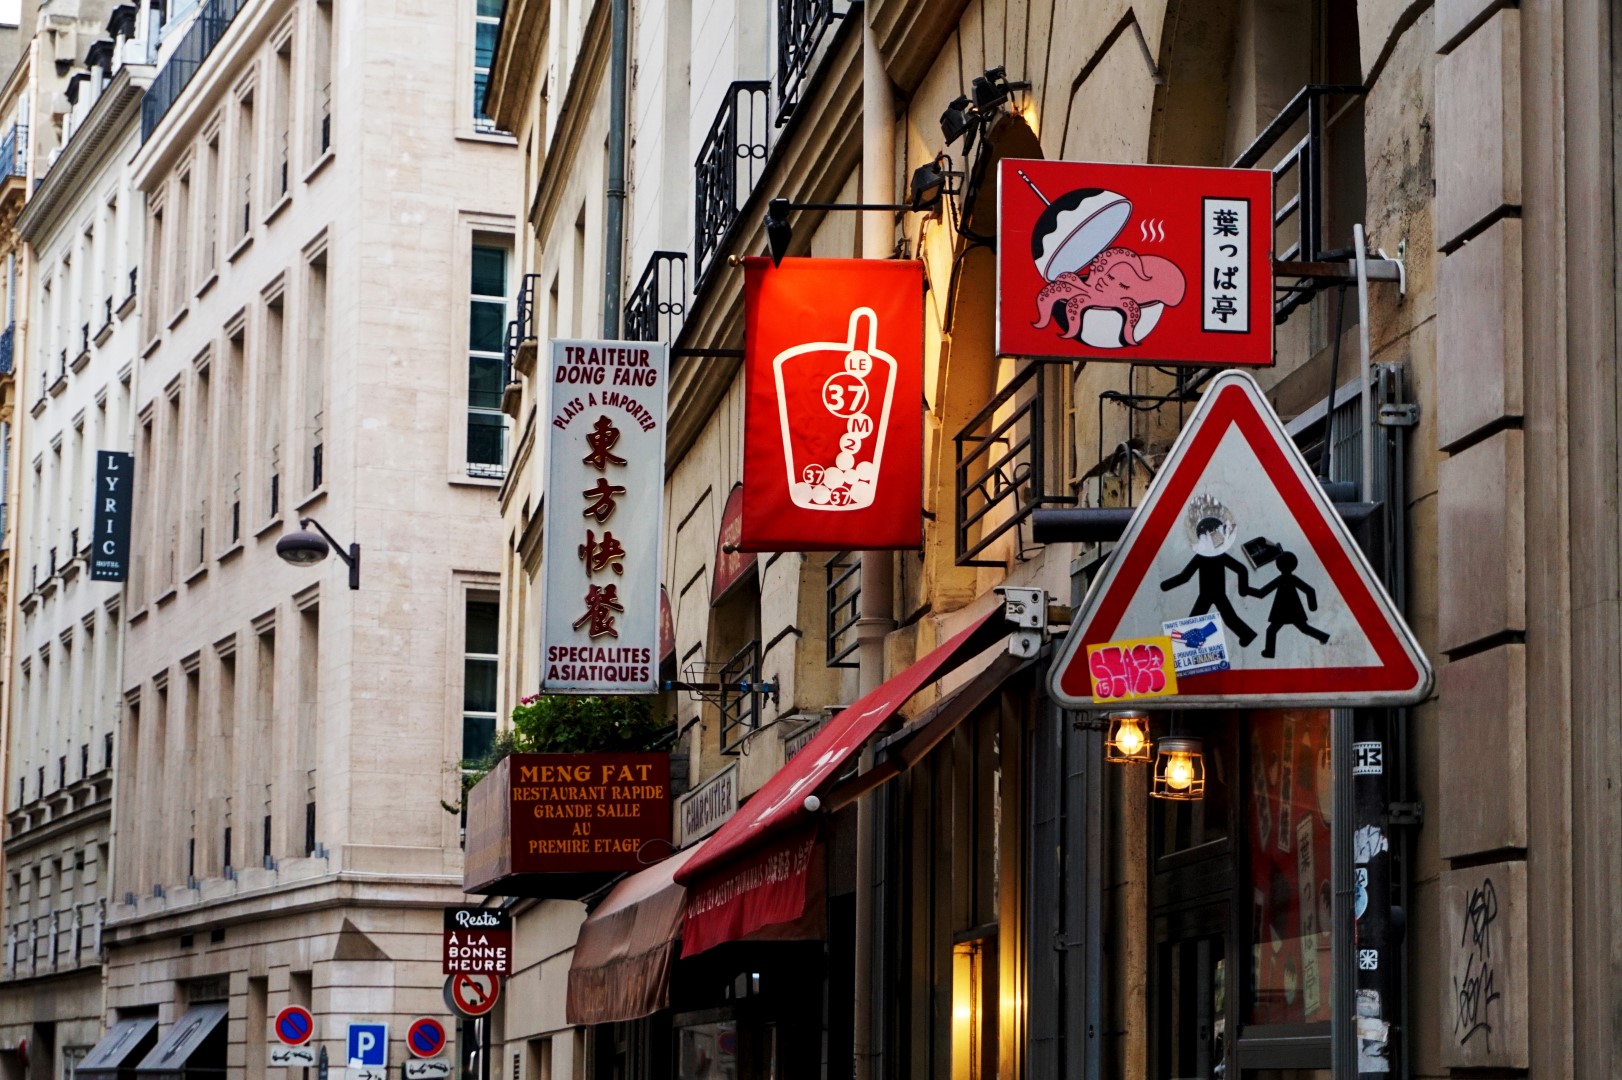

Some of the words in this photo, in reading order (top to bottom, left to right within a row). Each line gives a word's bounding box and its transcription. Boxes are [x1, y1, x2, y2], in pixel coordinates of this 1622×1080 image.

[1211, 208, 1240, 324] 葉っぱ亭
[565, 346, 650, 368] TRAITEUR
[849, 358, 867, 371] LE
[555, 365, 606, 385] DONG
[612, 367, 658, 387] FANG
[827, 384, 865, 412] 37
[552, 397, 585, 431] PLATS
[588, 392, 598, 408] A
[601, 390, 657, 433] EMPORTER
[851, 418, 869, 433] M
[843, 438, 856, 451] 2
[804, 469, 824, 484] 37
[102, 455, 120, 555] LYRIC
[830, 491, 850, 506] 37
[548, 646, 651, 664] SPECIALITES
[547, 664, 650, 683] ASIATIQUES
[519, 765, 592, 783] MENG
[601, 764, 652, 784] FAT
[513, 786, 607, 801] RESTAURANT
[611, 785, 664, 800] RAPIDE
[533, 804, 593, 819] GRANDE
[596, 803, 641, 818] SALLE
[686, 777, 733, 836] CHARCUTIER
[572, 822, 591, 836] AU
[528, 839, 590, 854] PREMIRE
[594, 838, 641, 853] ETAGE
[448, 931, 459, 945] À
[467, 934, 488, 946] LA
[448, 946, 507, 959] BONNE
[448, 959, 507, 971] HEURE
[358, 1032, 376, 1059] P
